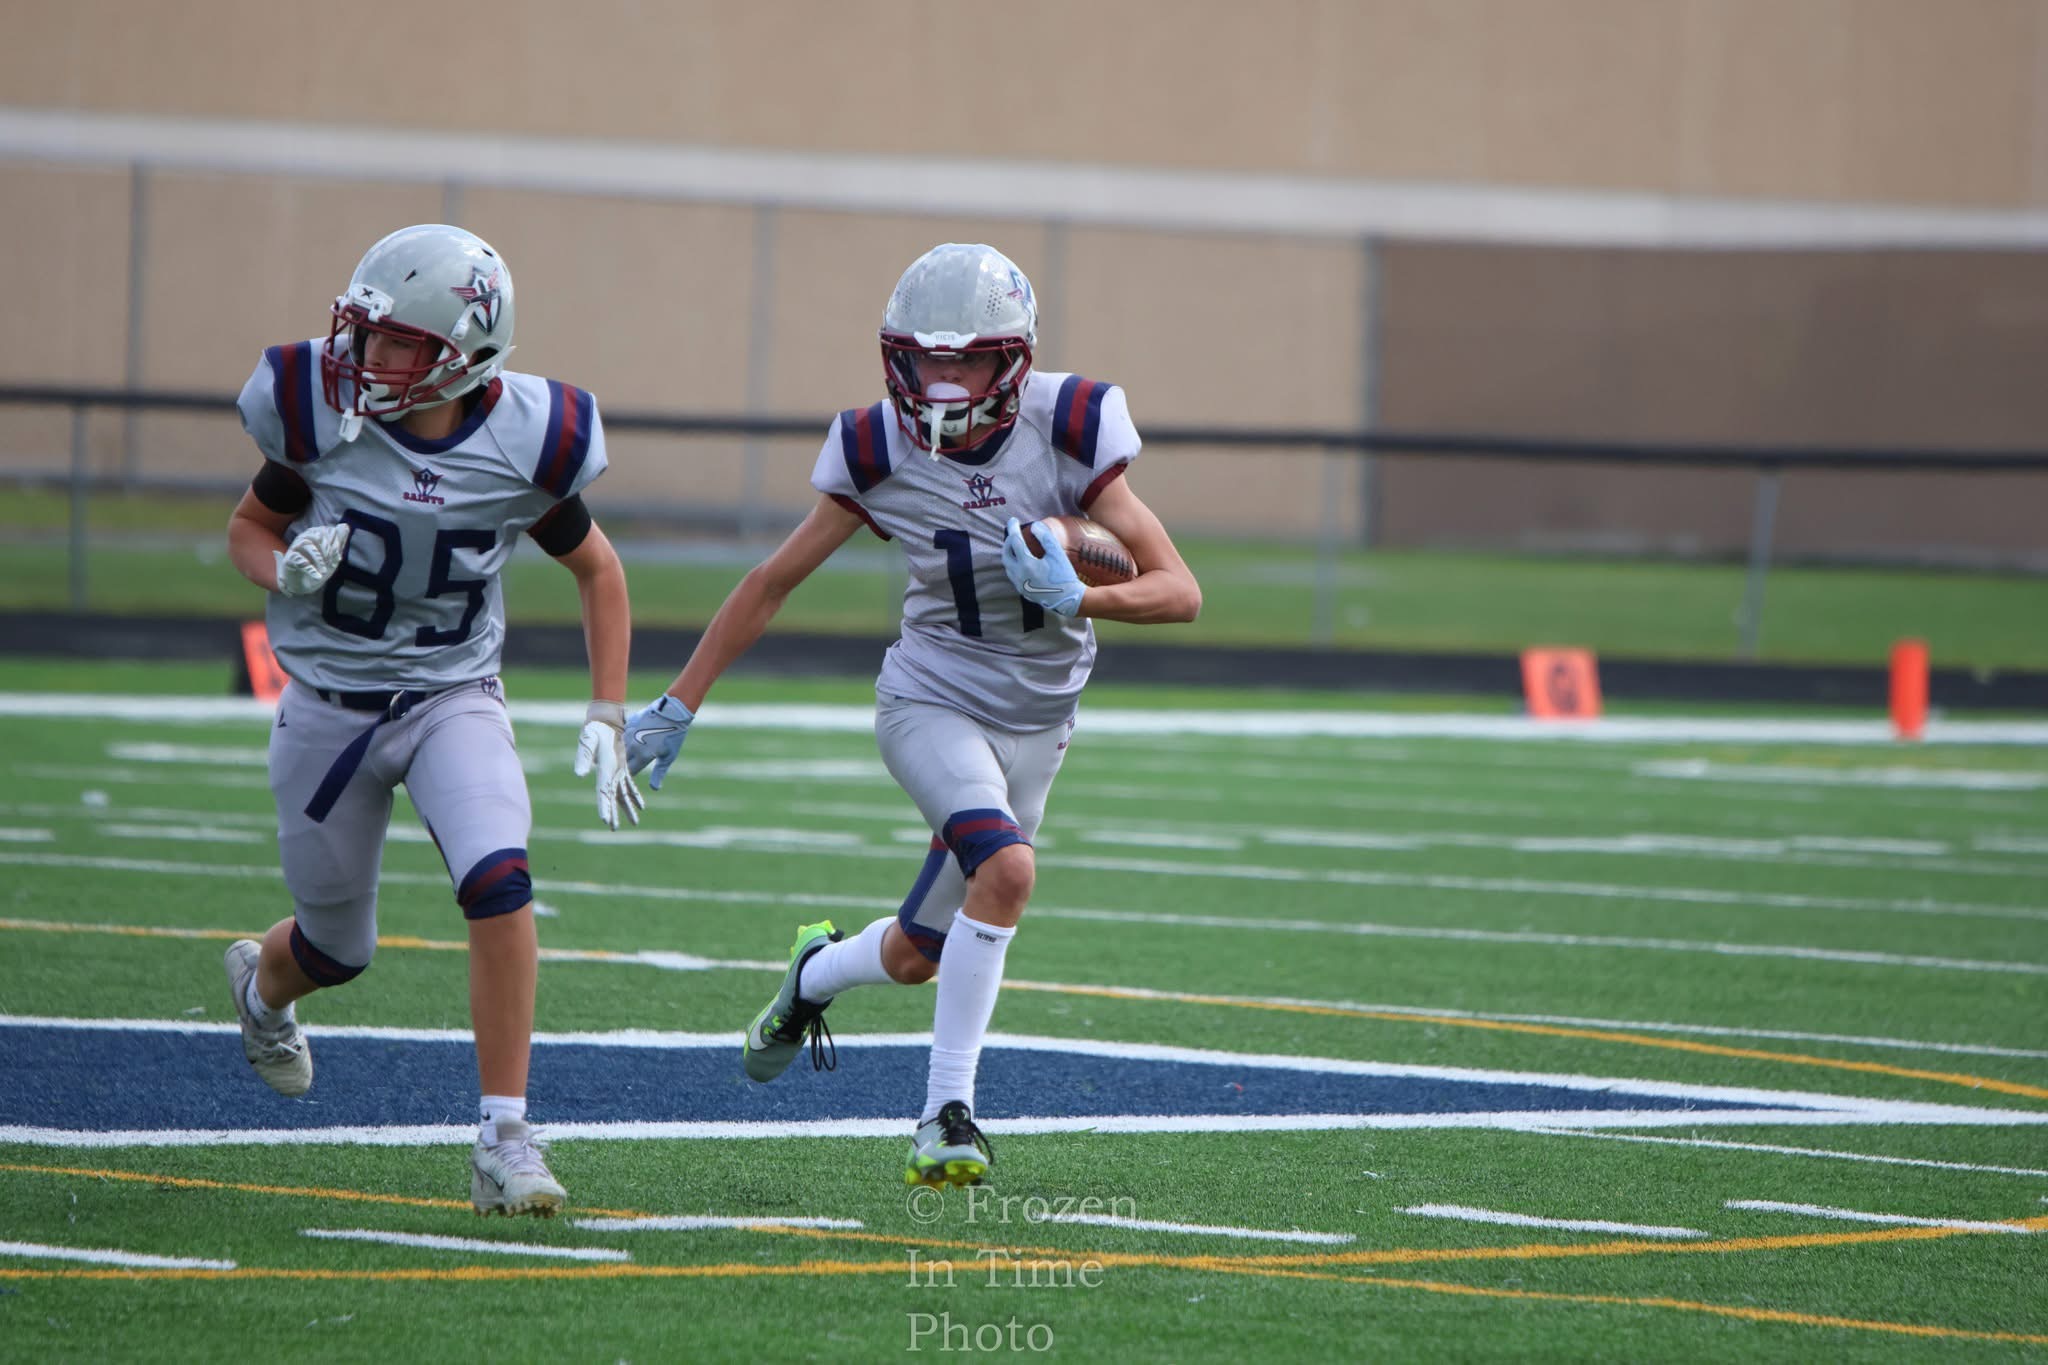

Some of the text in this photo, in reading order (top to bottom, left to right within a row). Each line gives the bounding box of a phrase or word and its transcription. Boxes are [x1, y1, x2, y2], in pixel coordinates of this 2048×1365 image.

[403, 492, 445, 505] SAINTS
[963, 496, 1006, 509] SAINTS
[321, 508, 496, 647] 85
